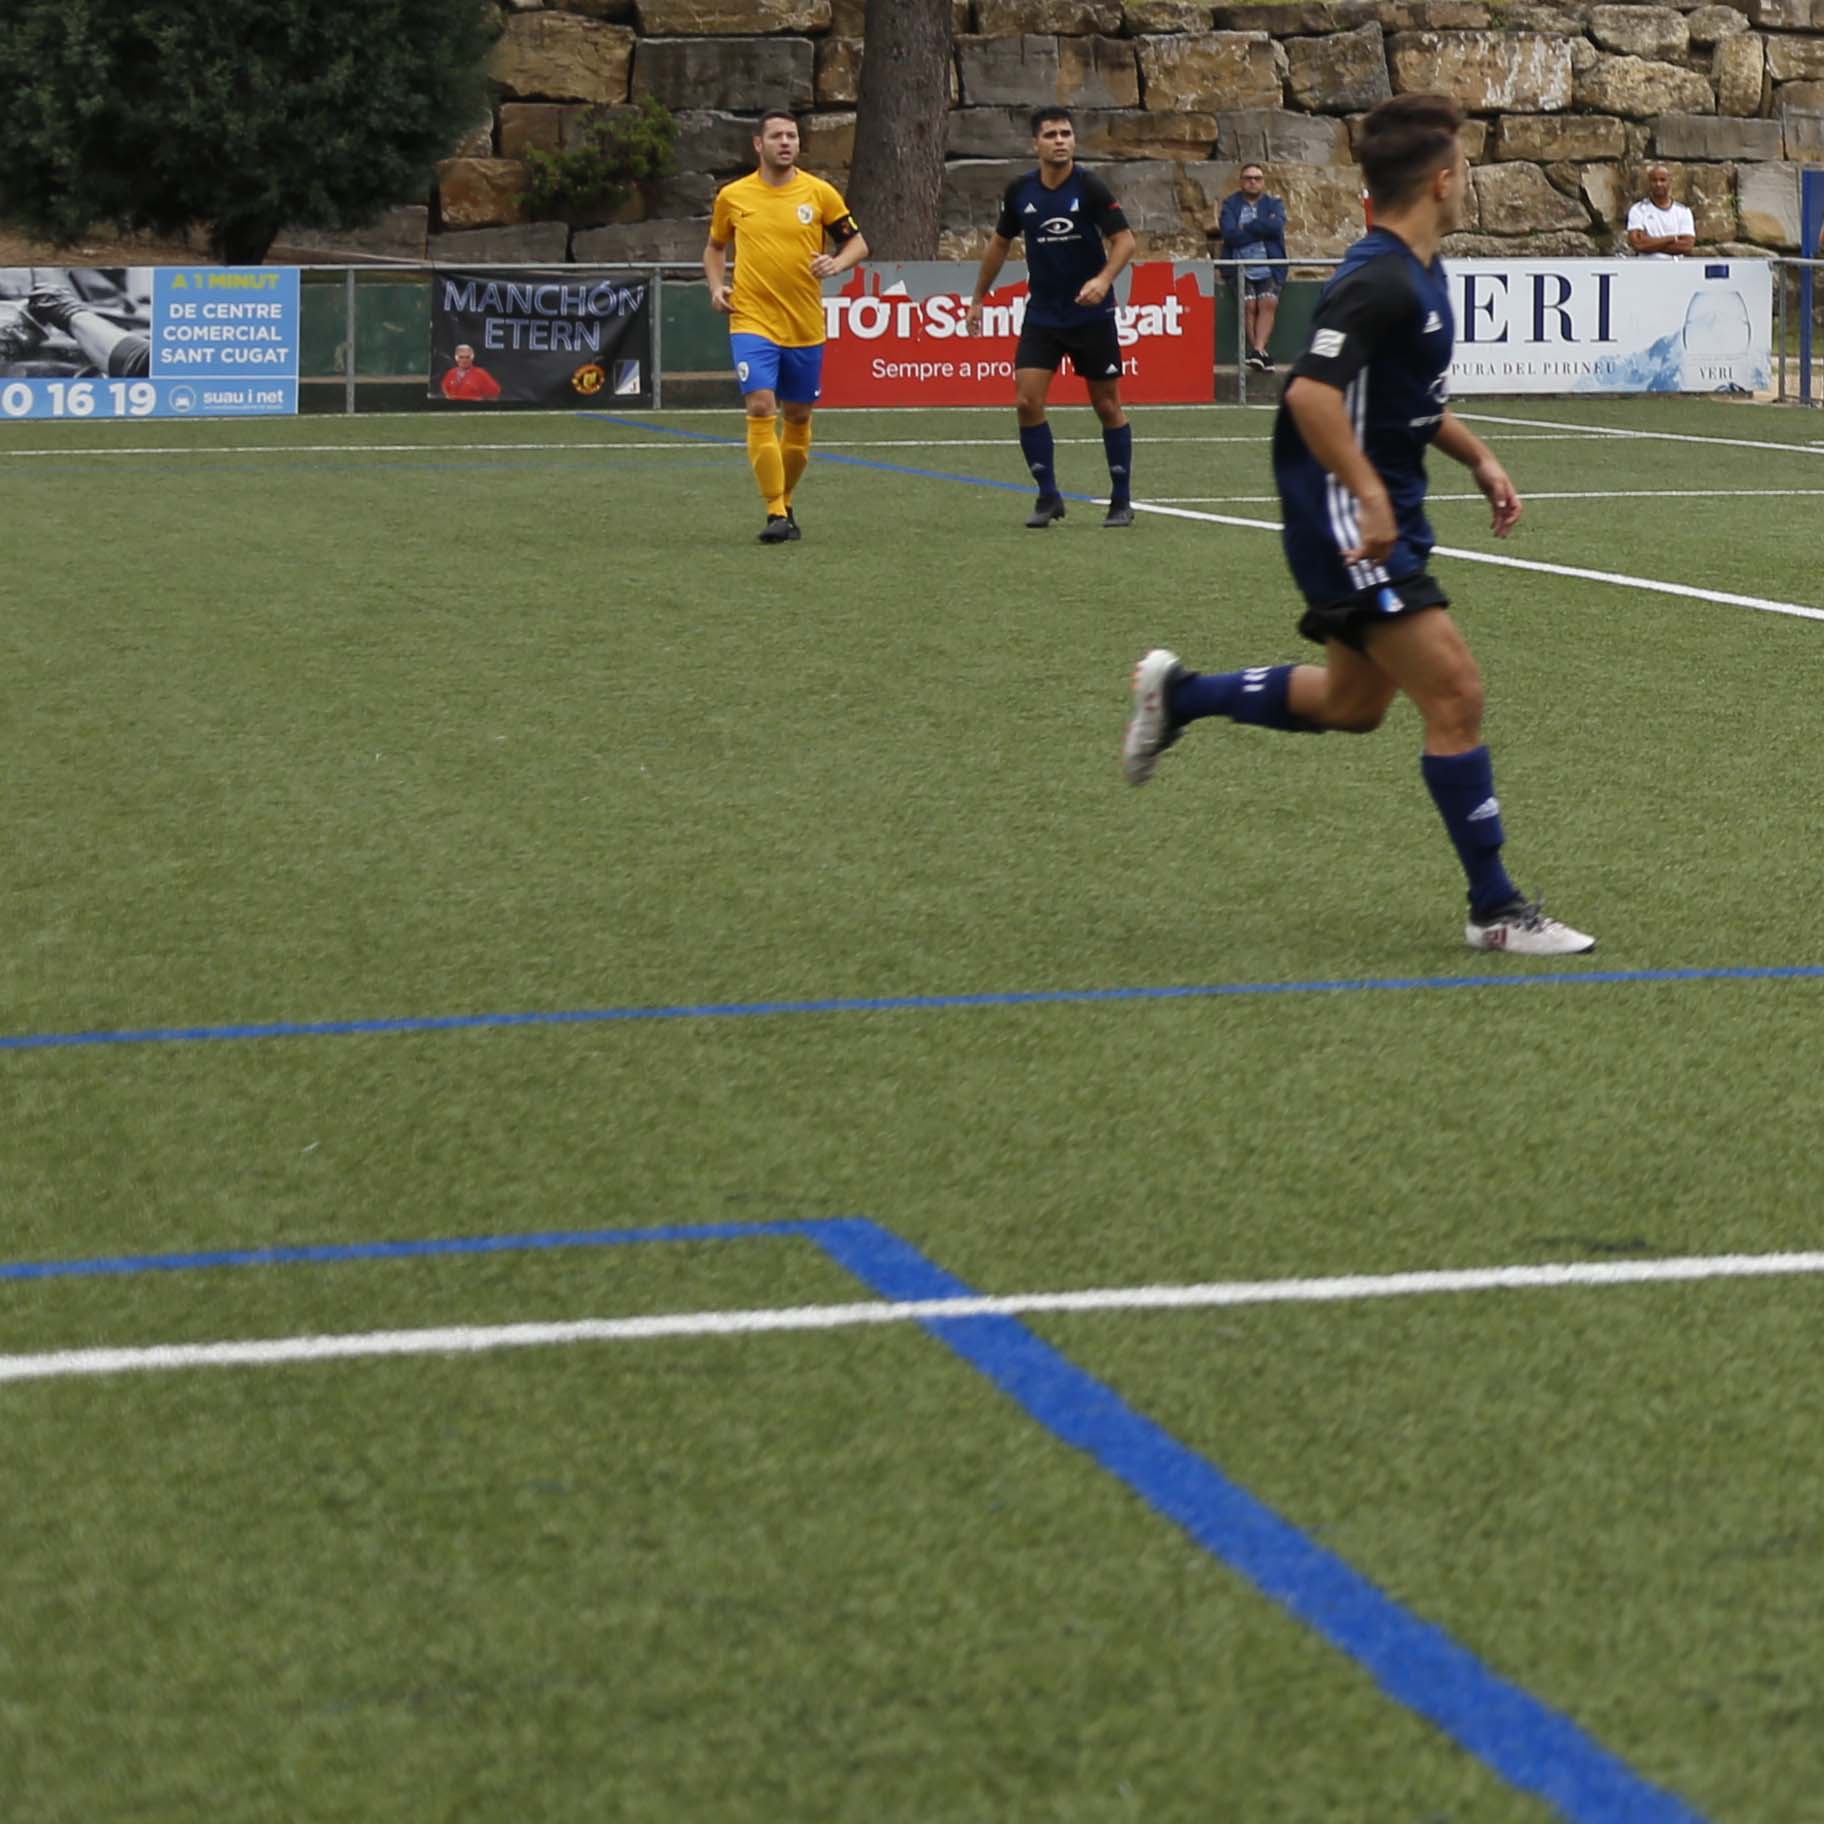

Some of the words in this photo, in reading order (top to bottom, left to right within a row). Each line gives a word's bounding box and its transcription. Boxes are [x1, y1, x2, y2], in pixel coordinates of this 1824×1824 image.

[443, 280, 644, 317] MANCHÓN
[169, 303, 197, 318] DE
[202, 303, 282, 318] CENTRE
[1456, 273, 1619, 344] ERI
[163, 326, 283, 341] COMERCIAL
[484, 317, 601, 351] ETERN
[161, 348, 215, 363] SANT
[221, 348, 289, 363] CUGAT
[872, 358, 954, 381] Sempre
[959, 362, 971, 377] a
[977, 361, 1016, 381] pro
[1451, 362, 1496, 375] PURA
[1503, 361, 1536, 375] DEL
[1543, 360, 1617, 375] PIRINEU
[1699, 366, 1734, 380] VERI
[47, 382, 95, 416] 16
[109, 382, 156, 416] 19
[257, 388, 284, 404] net
